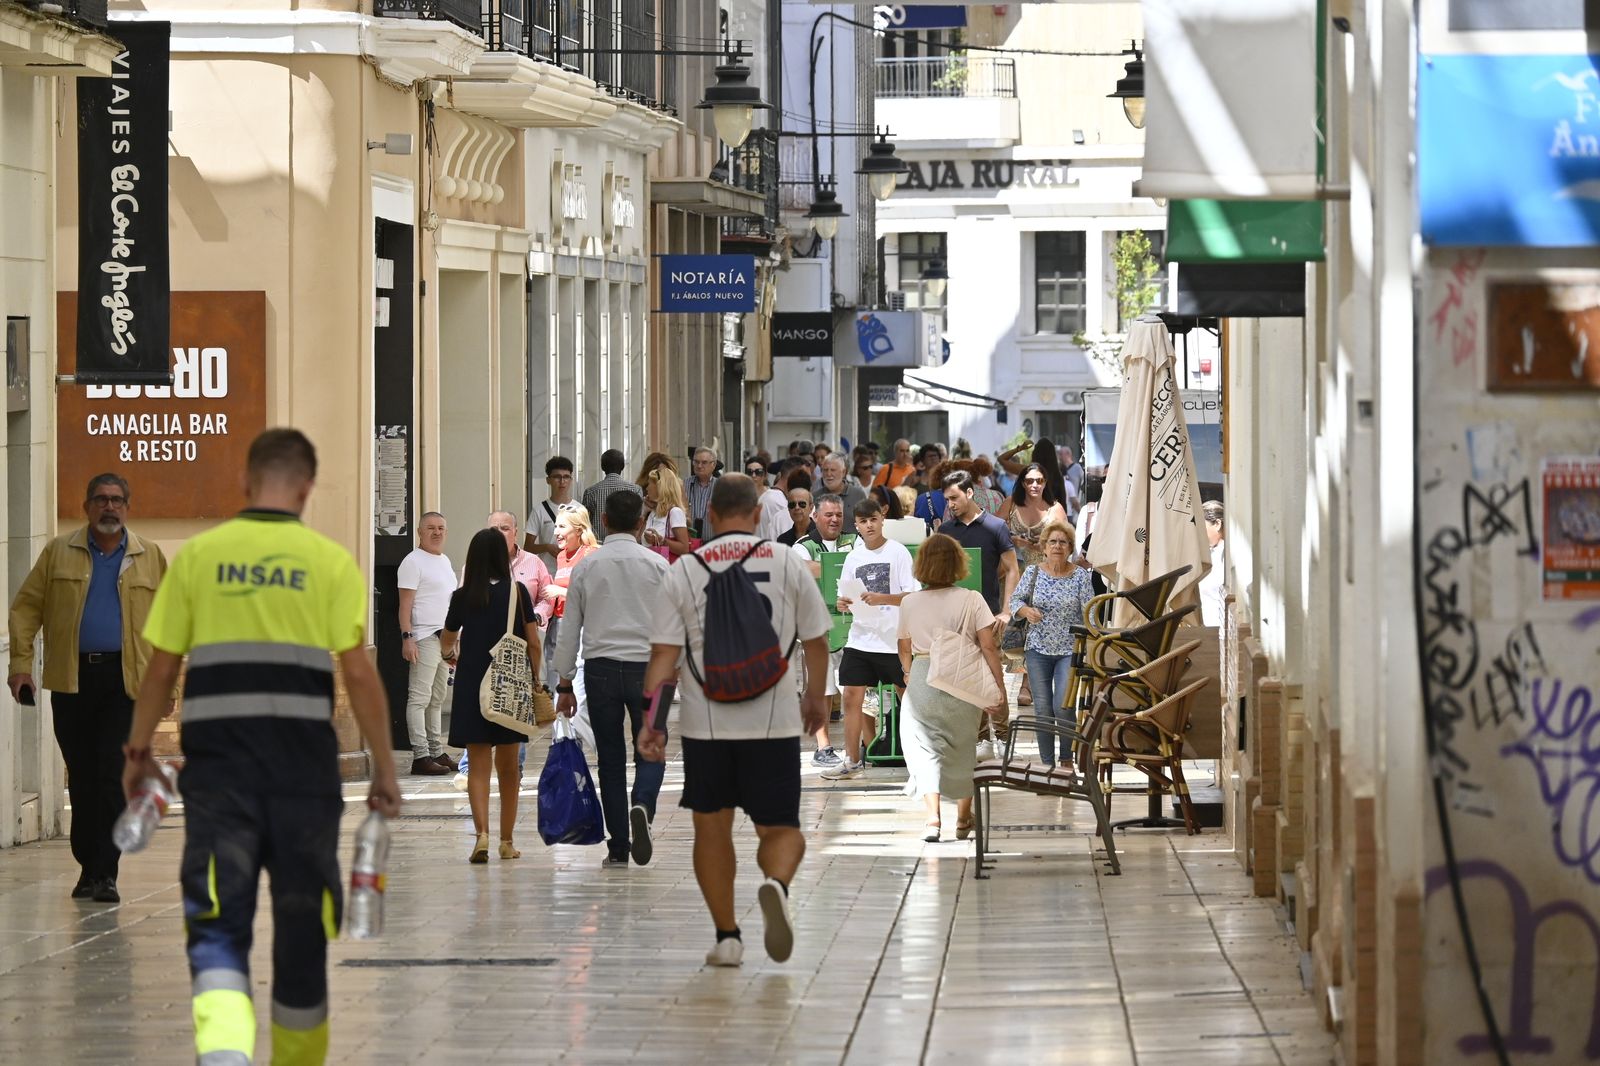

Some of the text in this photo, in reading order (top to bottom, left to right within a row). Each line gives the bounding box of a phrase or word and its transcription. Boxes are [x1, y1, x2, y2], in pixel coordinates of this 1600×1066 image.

[107, 50, 130, 154] VIAJES
[895, 159, 1080, 191] AJA RURAL
[671, 268, 746, 285] NOTARÍA
[683, 290, 711, 300] ÁBALOS
[715, 292, 744, 300] NUEVO
[773, 329, 829, 340] MANGO
[86, 413, 228, 436] CANAGLIA BAR
[119, 440, 197, 462] & RESTO
[217, 562, 308, 591] INSAE
[503, 649, 512, 665] USA
